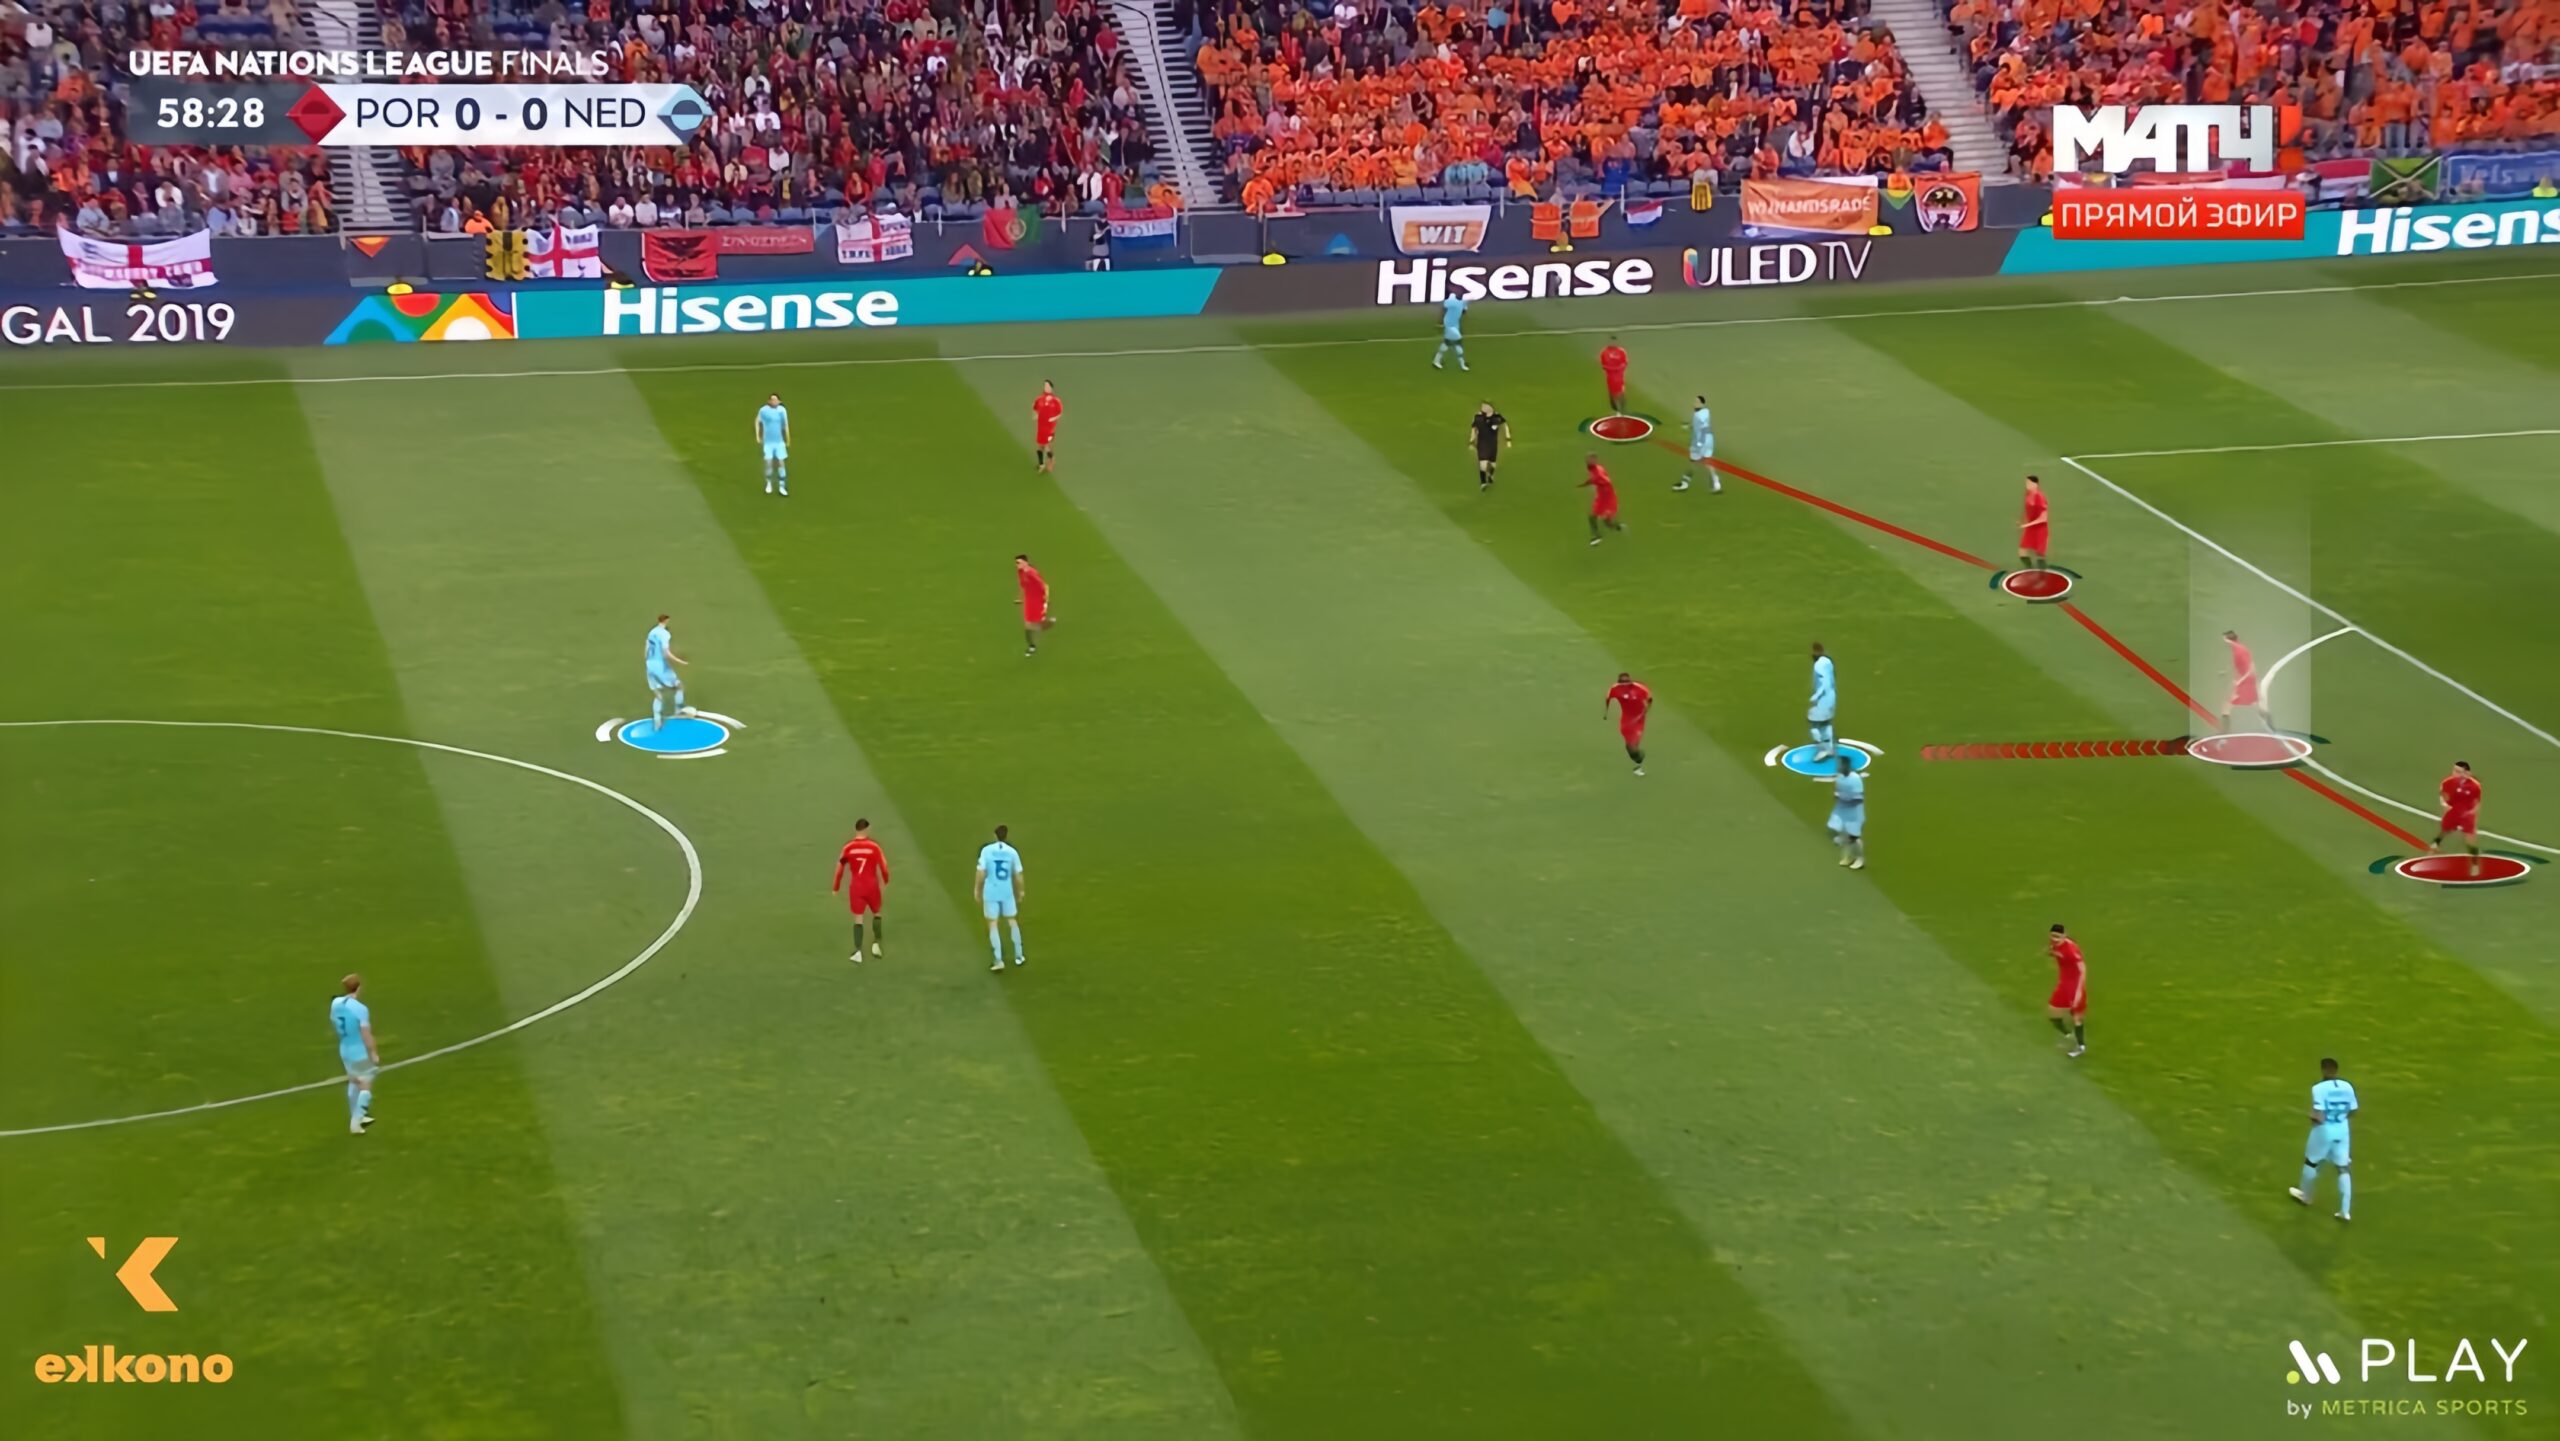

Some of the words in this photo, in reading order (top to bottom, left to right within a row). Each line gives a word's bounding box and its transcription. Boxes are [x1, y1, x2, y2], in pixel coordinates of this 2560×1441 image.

[1419, 225, 1466, 244] WIT
[1377, 257, 1654, 305] Hisense
[1683, 243, 1818, 287] ULED
[1822, 240, 1873, 281] TV
[1, 306, 113, 345] GAL
[126, 303, 236, 342] 2019
[603, 287, 899, 335] Hisense
[856, 857, 867, 875] 7
